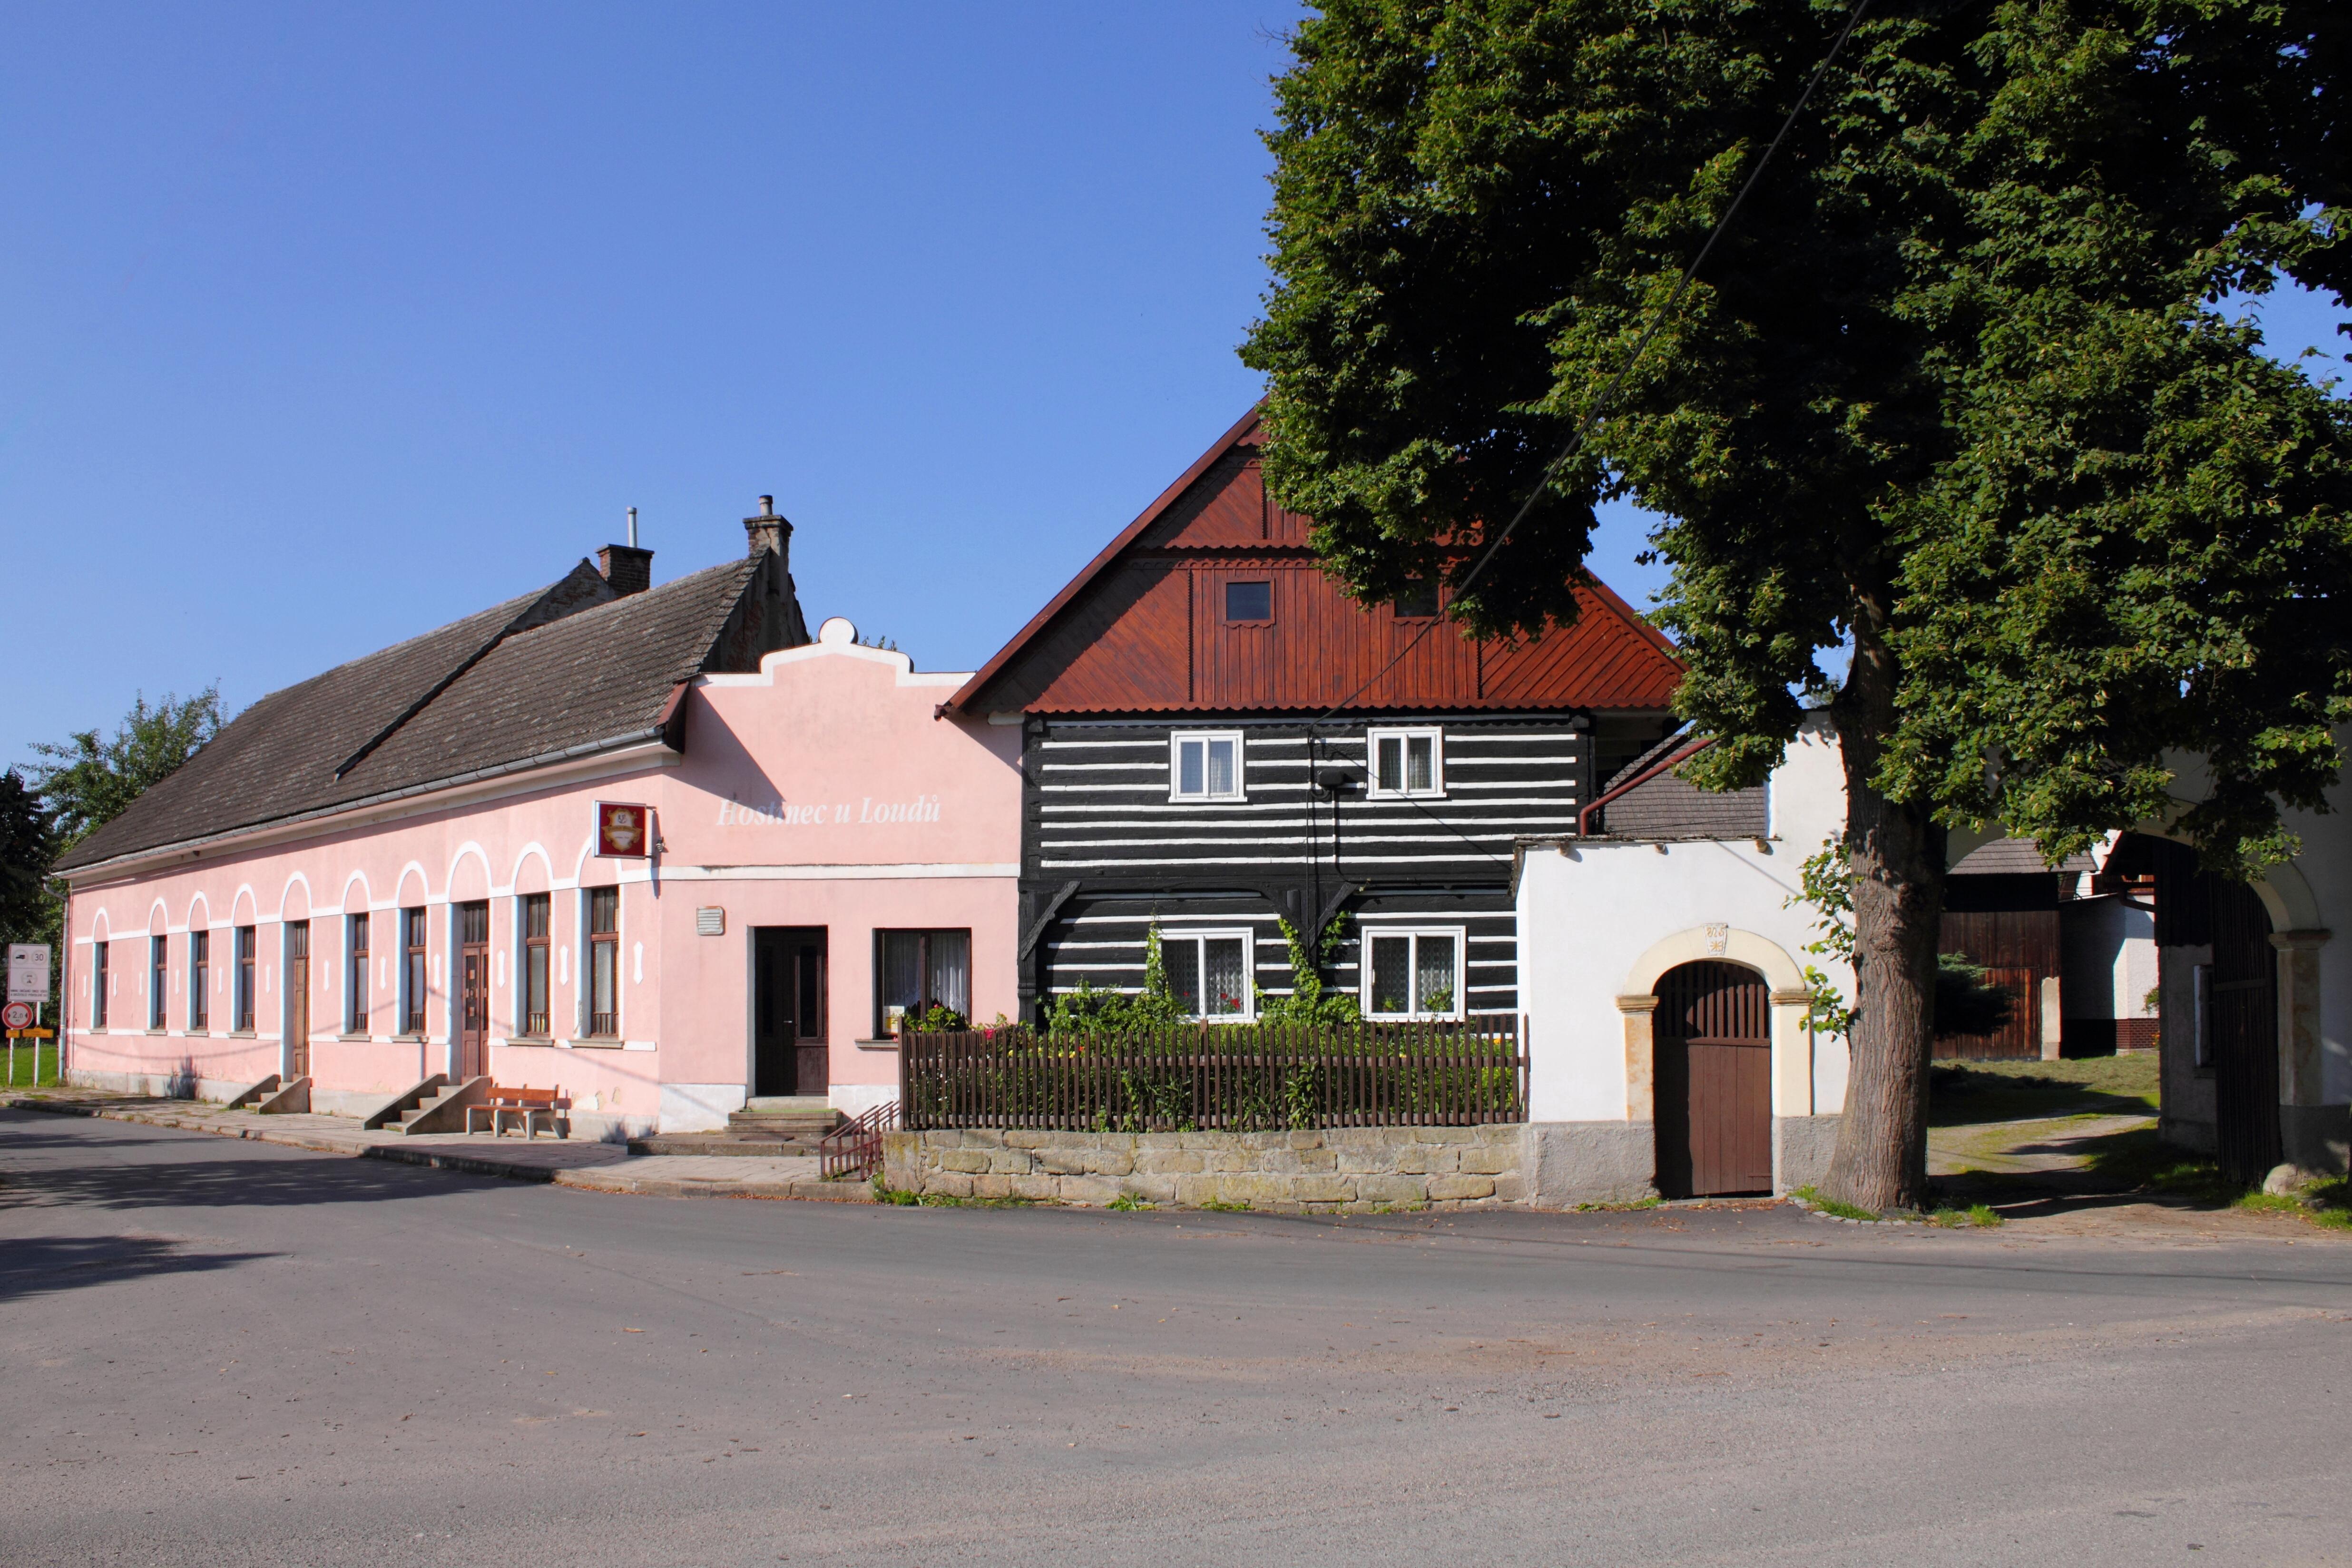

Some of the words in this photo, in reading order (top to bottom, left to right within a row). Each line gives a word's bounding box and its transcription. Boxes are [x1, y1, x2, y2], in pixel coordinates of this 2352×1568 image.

[715, 798, 827, 825] Hostinec
[835, 804, 851, 823] u
[858, 794, 941, 823] Loudů
